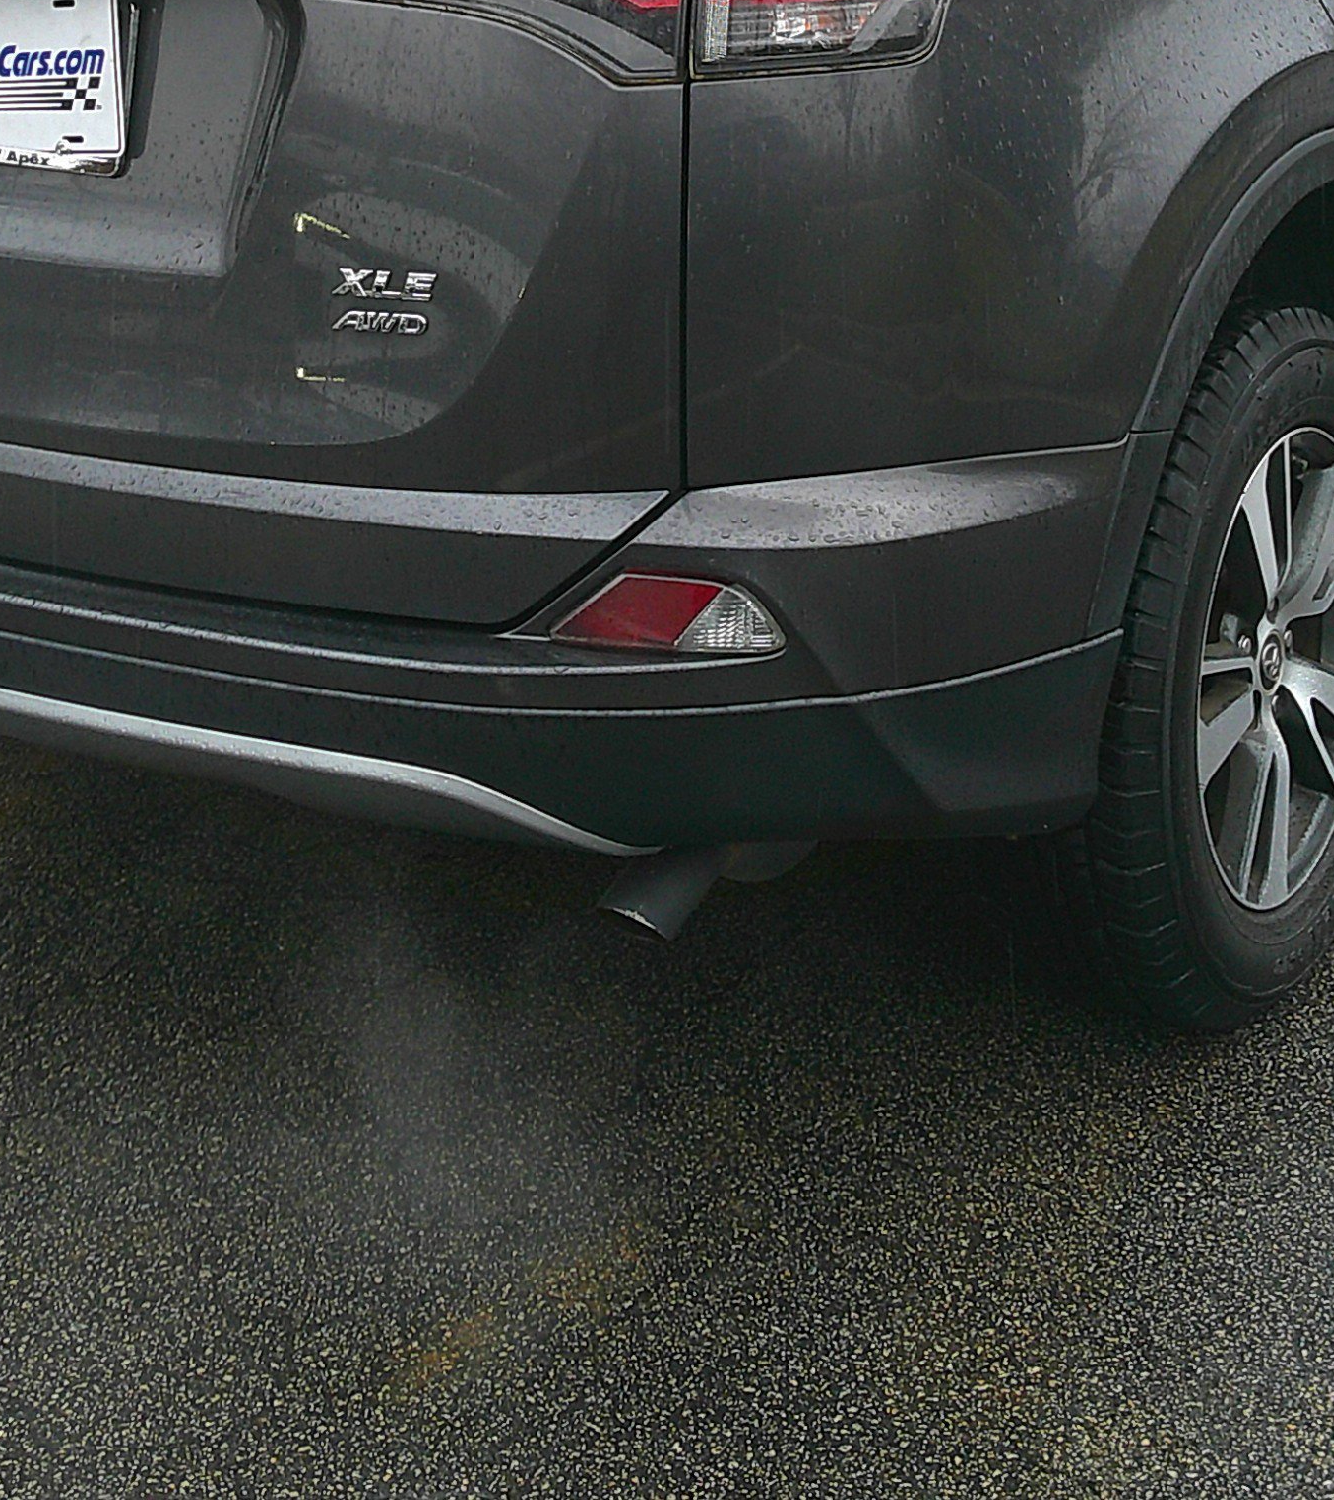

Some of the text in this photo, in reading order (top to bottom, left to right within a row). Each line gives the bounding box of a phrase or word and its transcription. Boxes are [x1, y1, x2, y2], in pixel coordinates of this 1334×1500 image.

[6, 151, 51, 167] Apex
[331, 267, 438, 302] XLE
[331, 309, 429, 336] AWD
